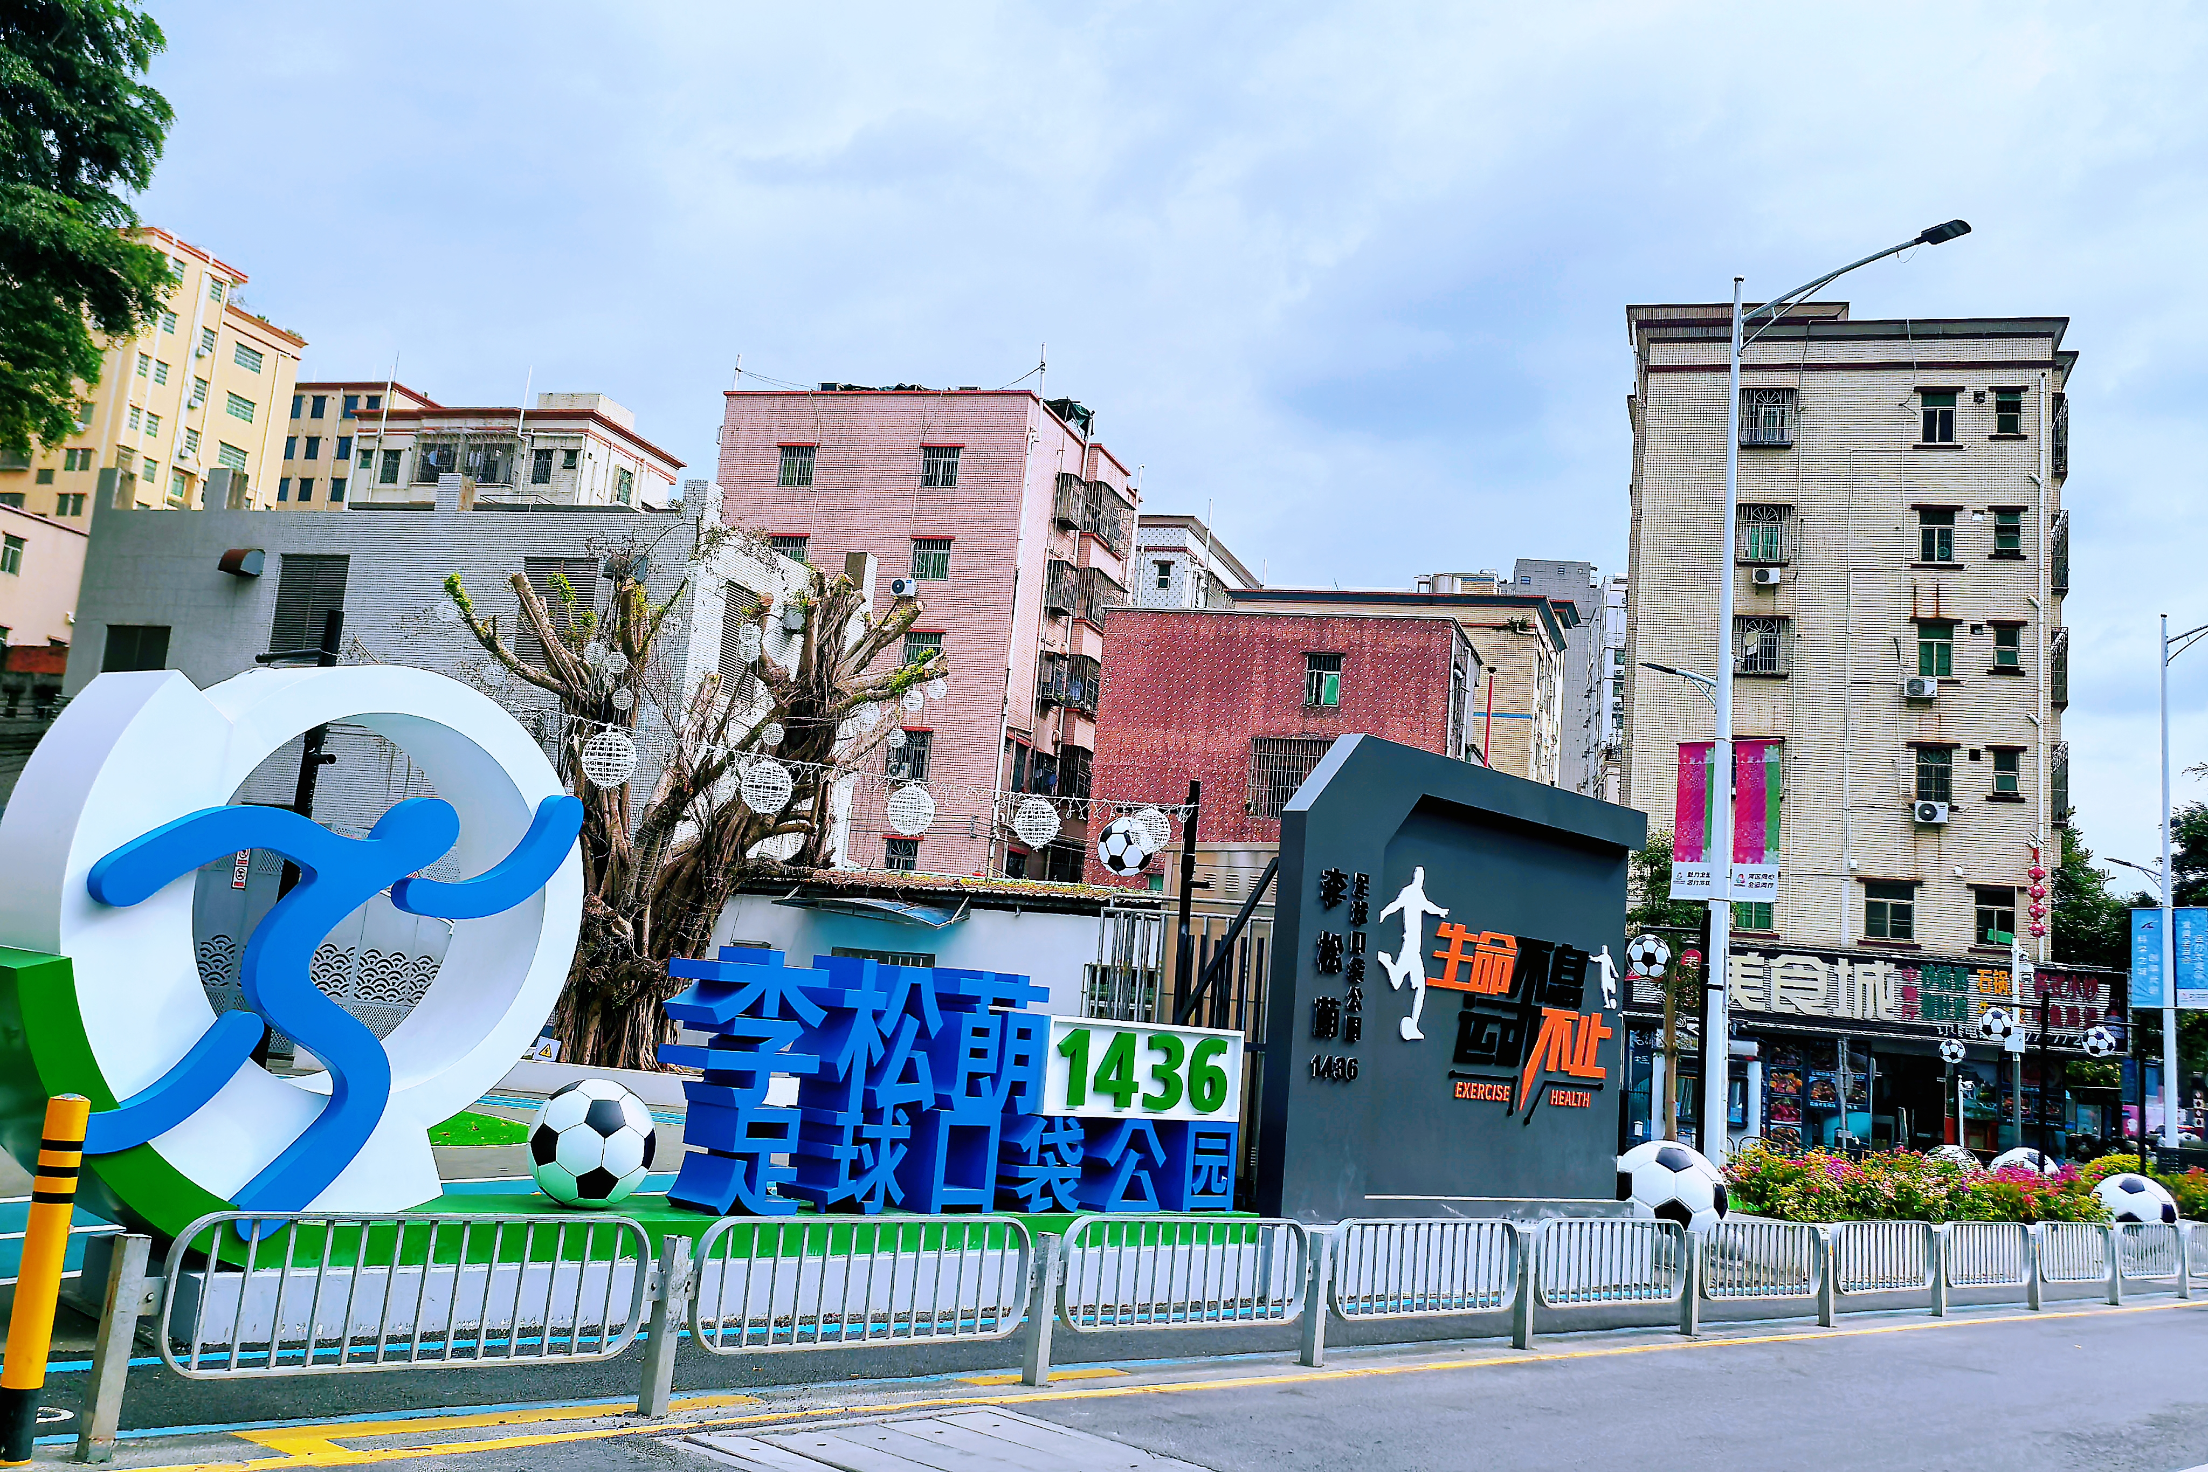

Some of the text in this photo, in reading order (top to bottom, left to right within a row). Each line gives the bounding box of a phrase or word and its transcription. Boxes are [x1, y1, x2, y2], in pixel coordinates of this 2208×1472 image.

[1426, 922, 1590, 1010] 生命不息
[1729, 951, 1896, 1020] 美食城
[1057, 1029, 1229, 1113] 1436
[1310, 1054, 1359, 1080] 1436
[1453, 993, 1612, 1110] 运动不止
[1454, 1081, 1511, 1102] EXERCISE
[1549, 1089, 1592, 1108] HEALTH
[667, 1103, 1237, 1216] 足球口袋公园
